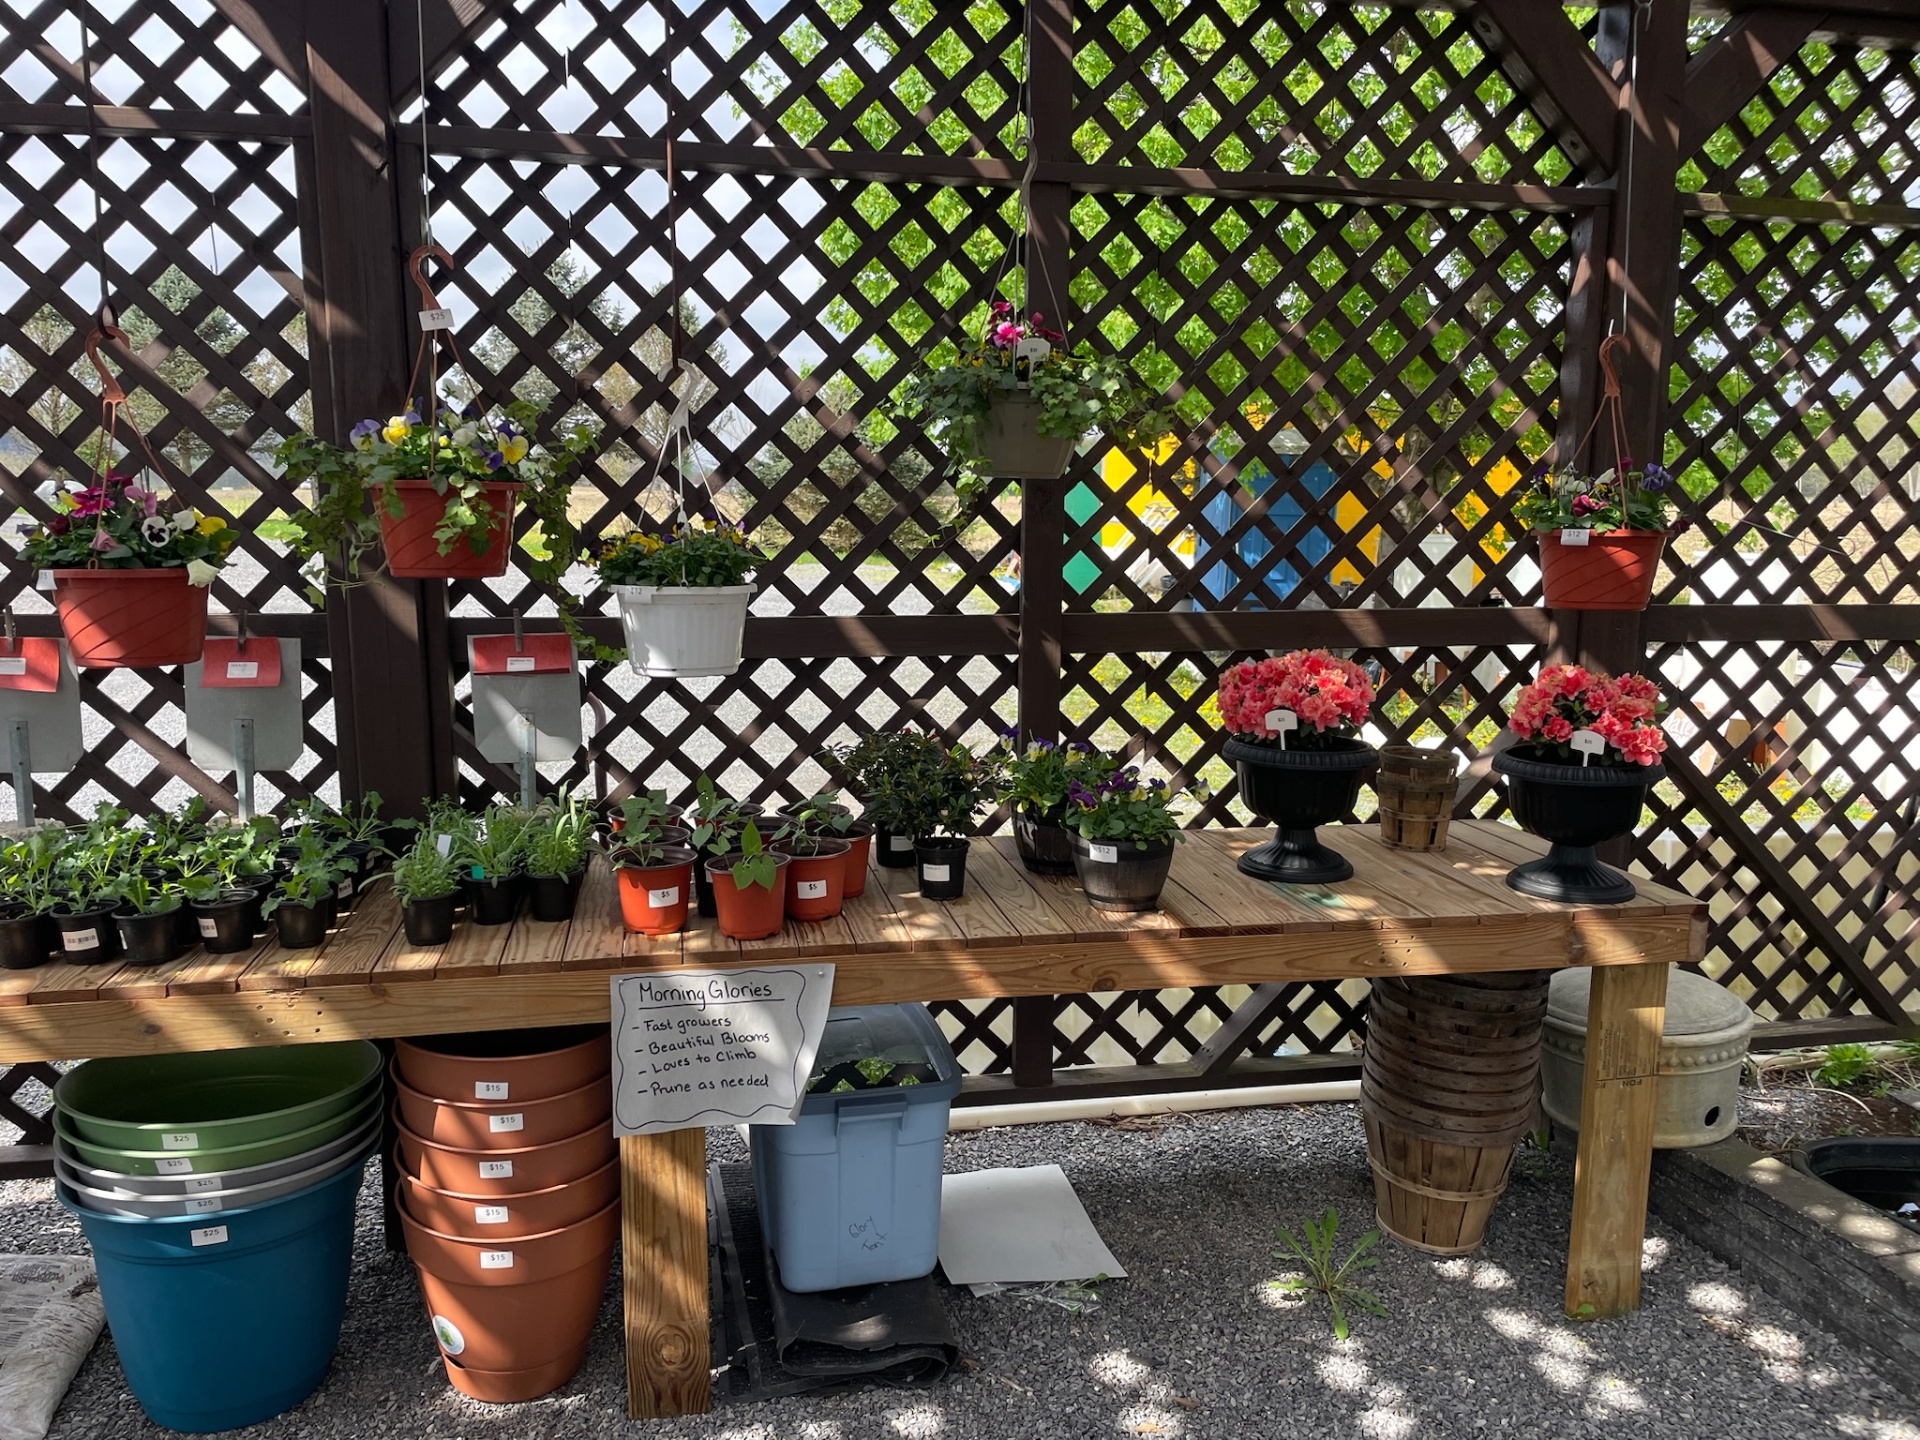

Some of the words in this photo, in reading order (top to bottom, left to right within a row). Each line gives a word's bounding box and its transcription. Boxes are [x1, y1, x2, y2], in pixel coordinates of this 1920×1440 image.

[430, 312, 446, 321] $25
[1097, 846, 1111, 854] $12
[808, 883, 818, 891] $5
[639, 982, 706, 1011] Morning
[708, 980, 772, 999] Glories
[643, 1019, 673, 1032] Fast
[678, 1017, 731, 1034] growers
[648, 1034, 714, 1055] Beautiful
[721, 1031, 770, 1045] Blooms
[651, 1056, 690, 1074] Loves
[696, 1052, 711, 1063] to
[716, 1048, 757, 1062] Climb
[485, 1084, 501, 1092] $15
[650, 1081, 691, 1096] Prune
[699, 1080, 715, 1090] as
[720, 1074, 769, 1088] needed
[500, 1116, 516, 1124] $15
[173, 1134, 190, 1142] $25
[489, 1163, 505, 1171] $15
[197, 1200, 214, 1208] $25
[203, 1229, 220, 1237] $25
